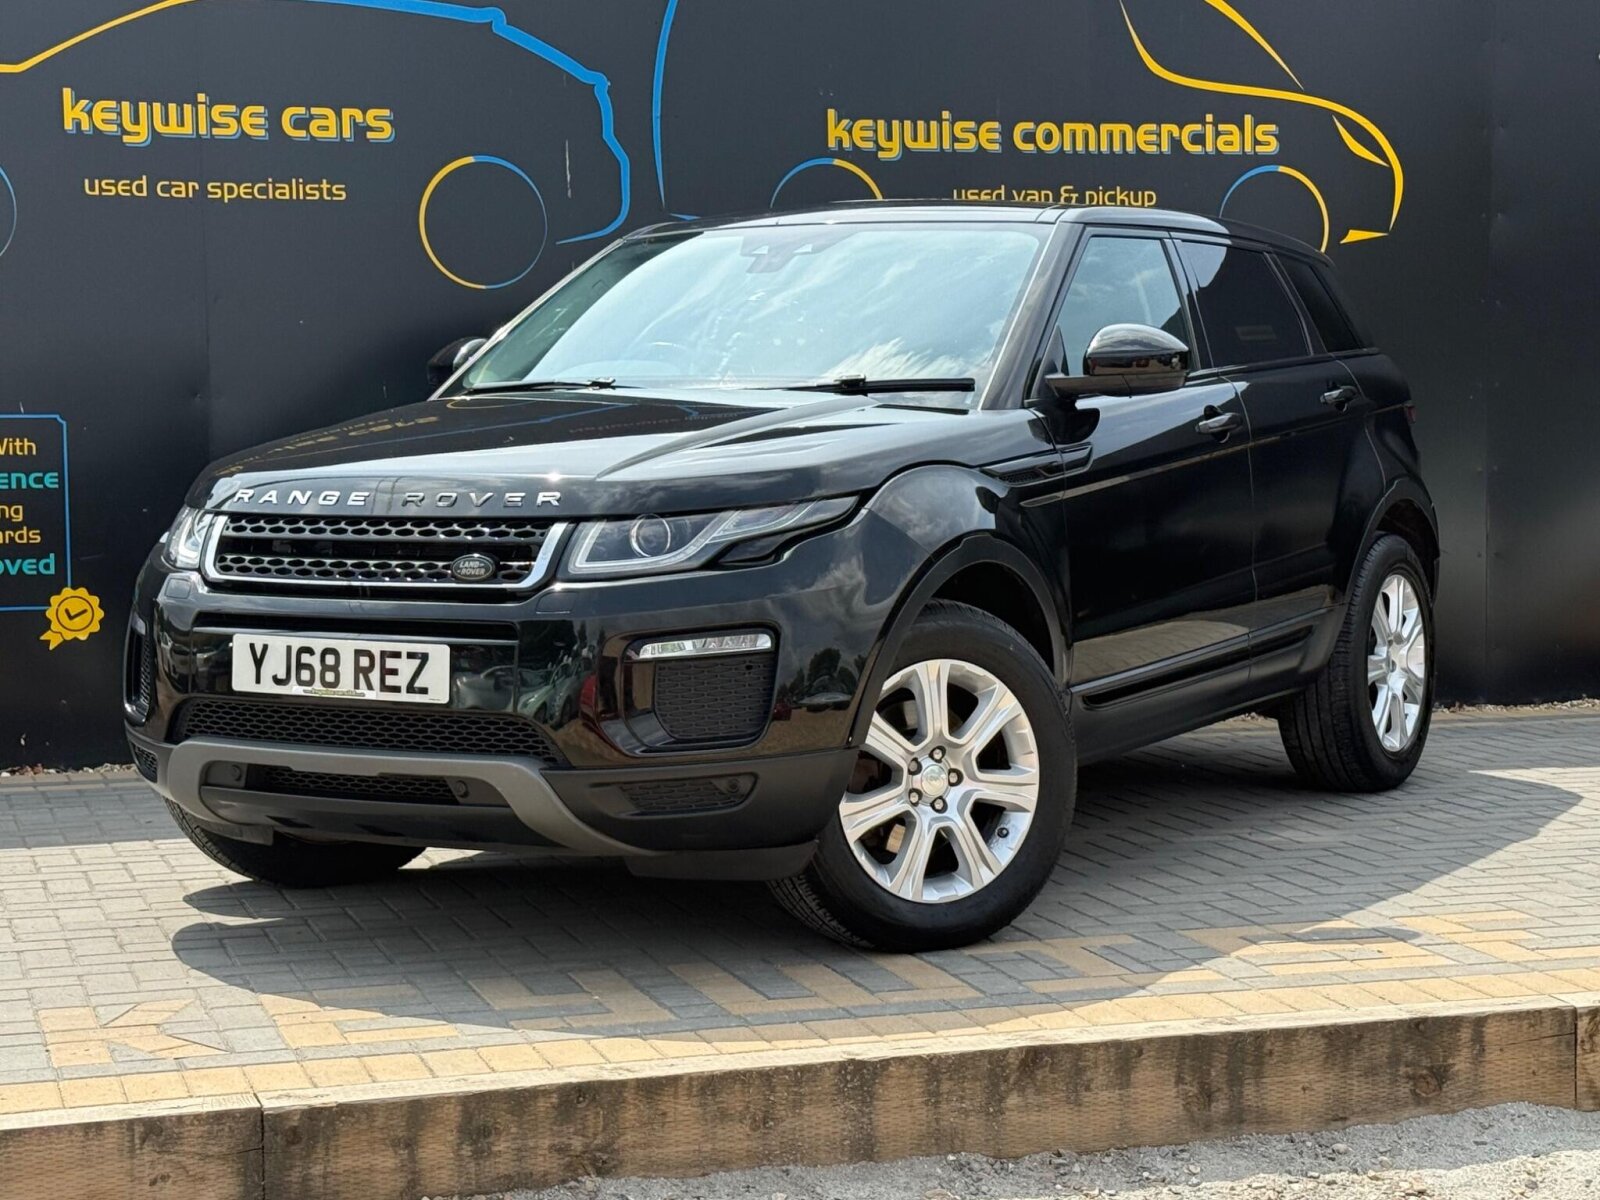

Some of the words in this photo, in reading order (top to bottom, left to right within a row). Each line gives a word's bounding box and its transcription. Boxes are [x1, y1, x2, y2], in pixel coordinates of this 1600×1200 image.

[62, 87, 269, 147] keywise
[281, 106, 396, 143] cars
[826, 108, 1002, 160] keywise
[1012, 114, 1280, 155] commercials
[84, 175, 147, 197] used
[156, 179, 199, 198] car
[207, 178, 347, 203] specialists
[953, 185, 1006, 201] used
[1012, 189, 1054, 203] van
[1085, 186, 1157, 207] pickup
[232, 489, 370, 507] RANGE
[401, 491, 562, 508] ROVER
[0, 526, 41, 544] rds
[459, 560, 480, 568] LAND
[460, 567, 486, 576] ROVER
[248, 643, 341, 689] YJ68
[353, 648, 429, 695] REZ
